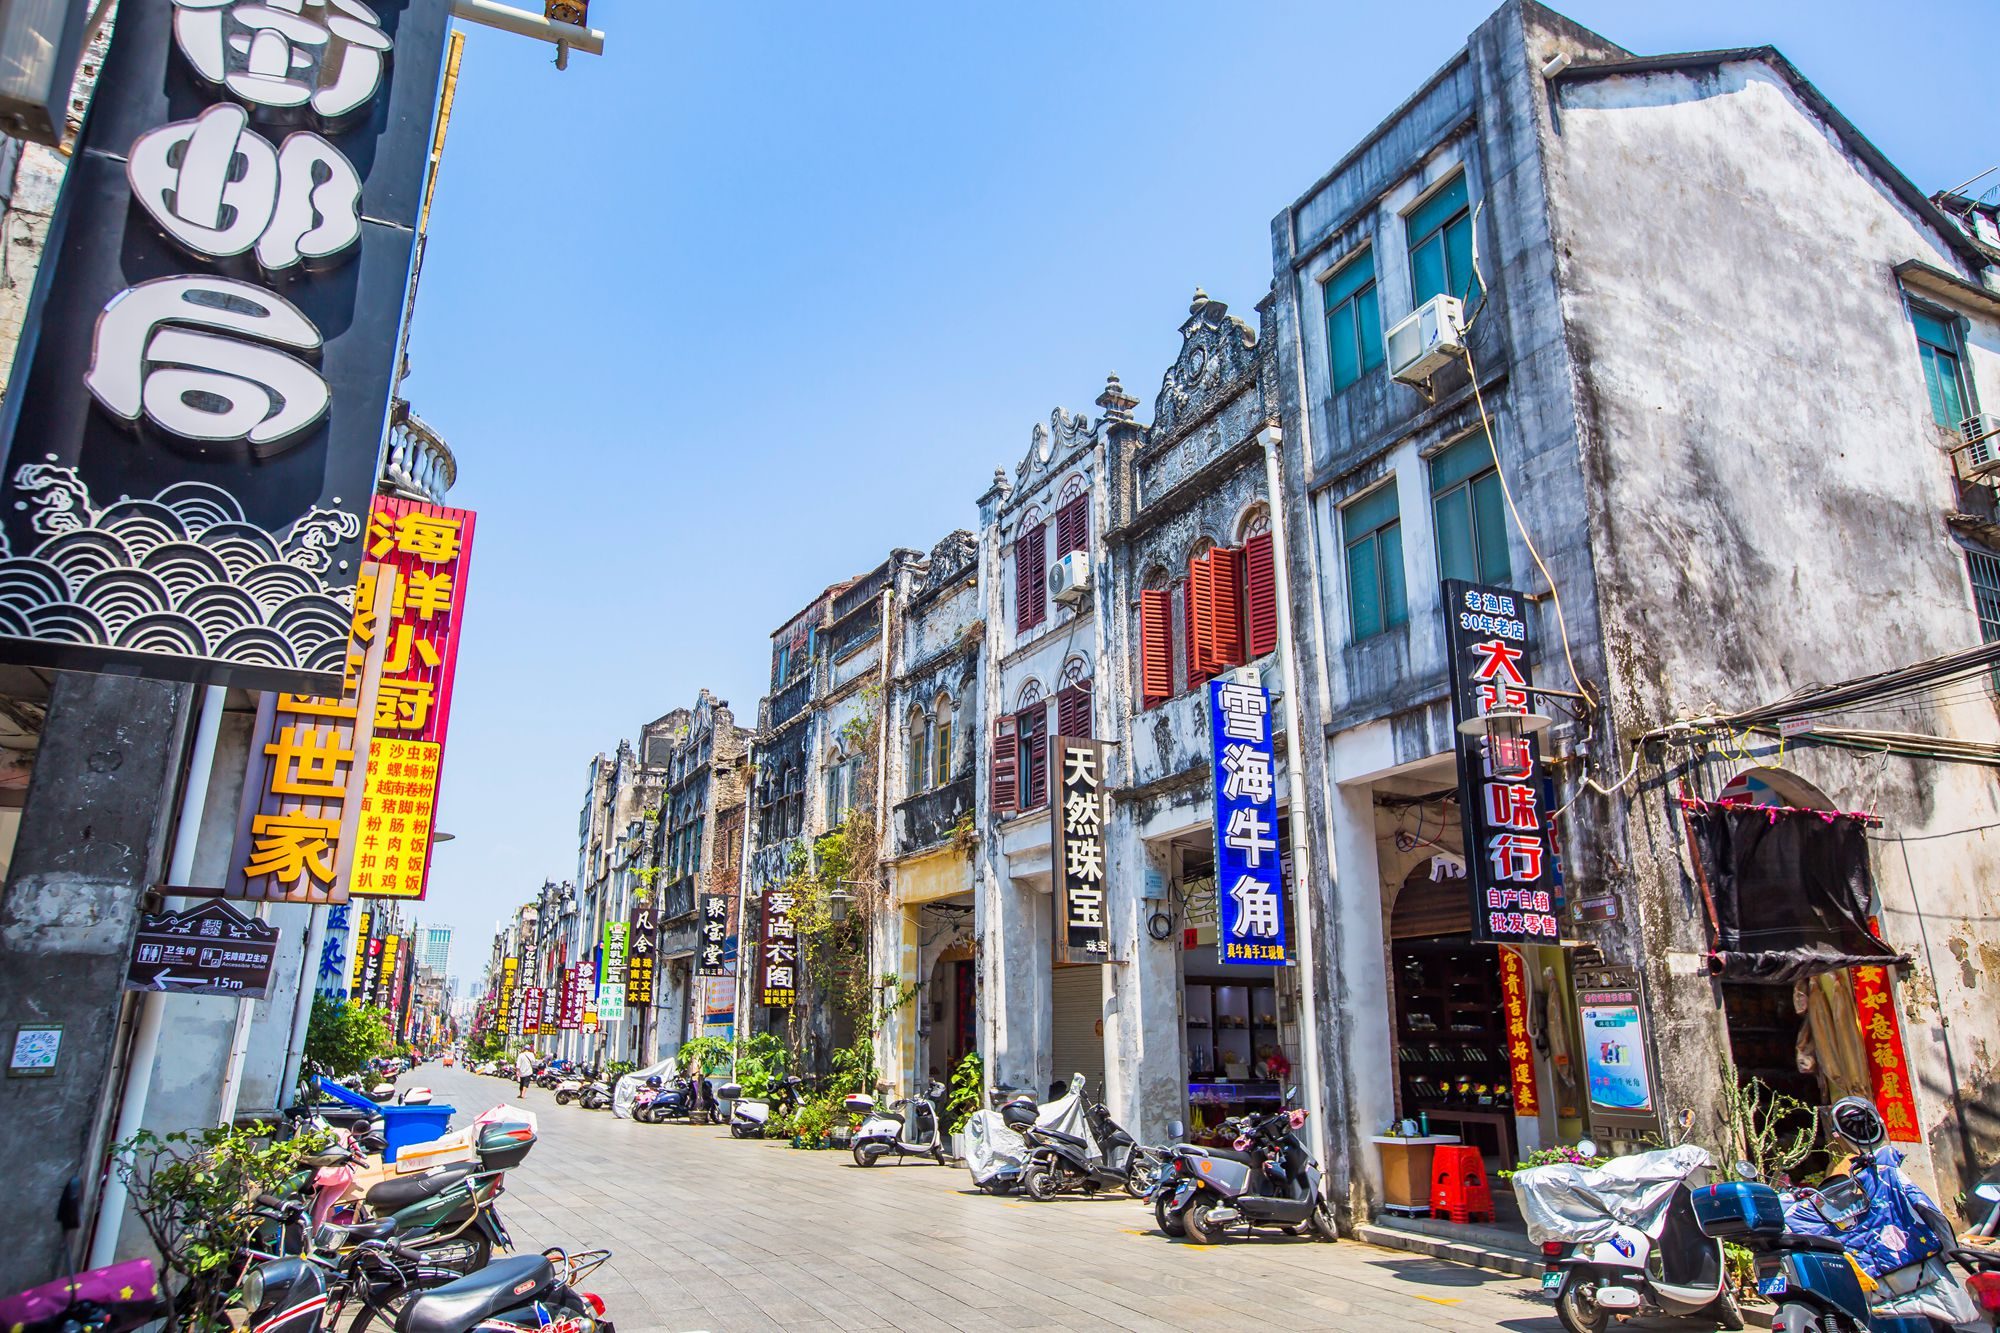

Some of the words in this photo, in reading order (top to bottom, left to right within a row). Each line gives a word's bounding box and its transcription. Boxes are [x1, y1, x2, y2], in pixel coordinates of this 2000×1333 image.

[1465, 590, 1515, 617] 老渔民
[372, 511, 462, 731] 海鲜小厨
[1460, 612, 1525, 641] 30年老店
[389, 743, 438, 762] 沙虫粥
[376, 779, 433, 798] 越南卷粉
[382, 799, 430, 816] 猪脚粉
[1219, 683, 1279, 938] 雪海牛角
[1065, 747, 1104, 928] 天然珠宝
[1487, 887, 1549, 912] 自产自销
[633, 910, 654, 953] 凡舍
[703, 897, 726, 965] 聚宝堂
[1489, 912, 1556, 936] 批发零售
[766, 892, 796, 988] 爱尚衣阁
[1086, 940, 1108, 953] 珠宝
[164, 945, 197, 956] 卫生间
[223, 951, 269, 964] 无障碍卫生间
[221, 961, 250, 969] Accessible
[212, 976, 244, 989] 15m
[639, 957, 653, 1003] 珠宝文玩
